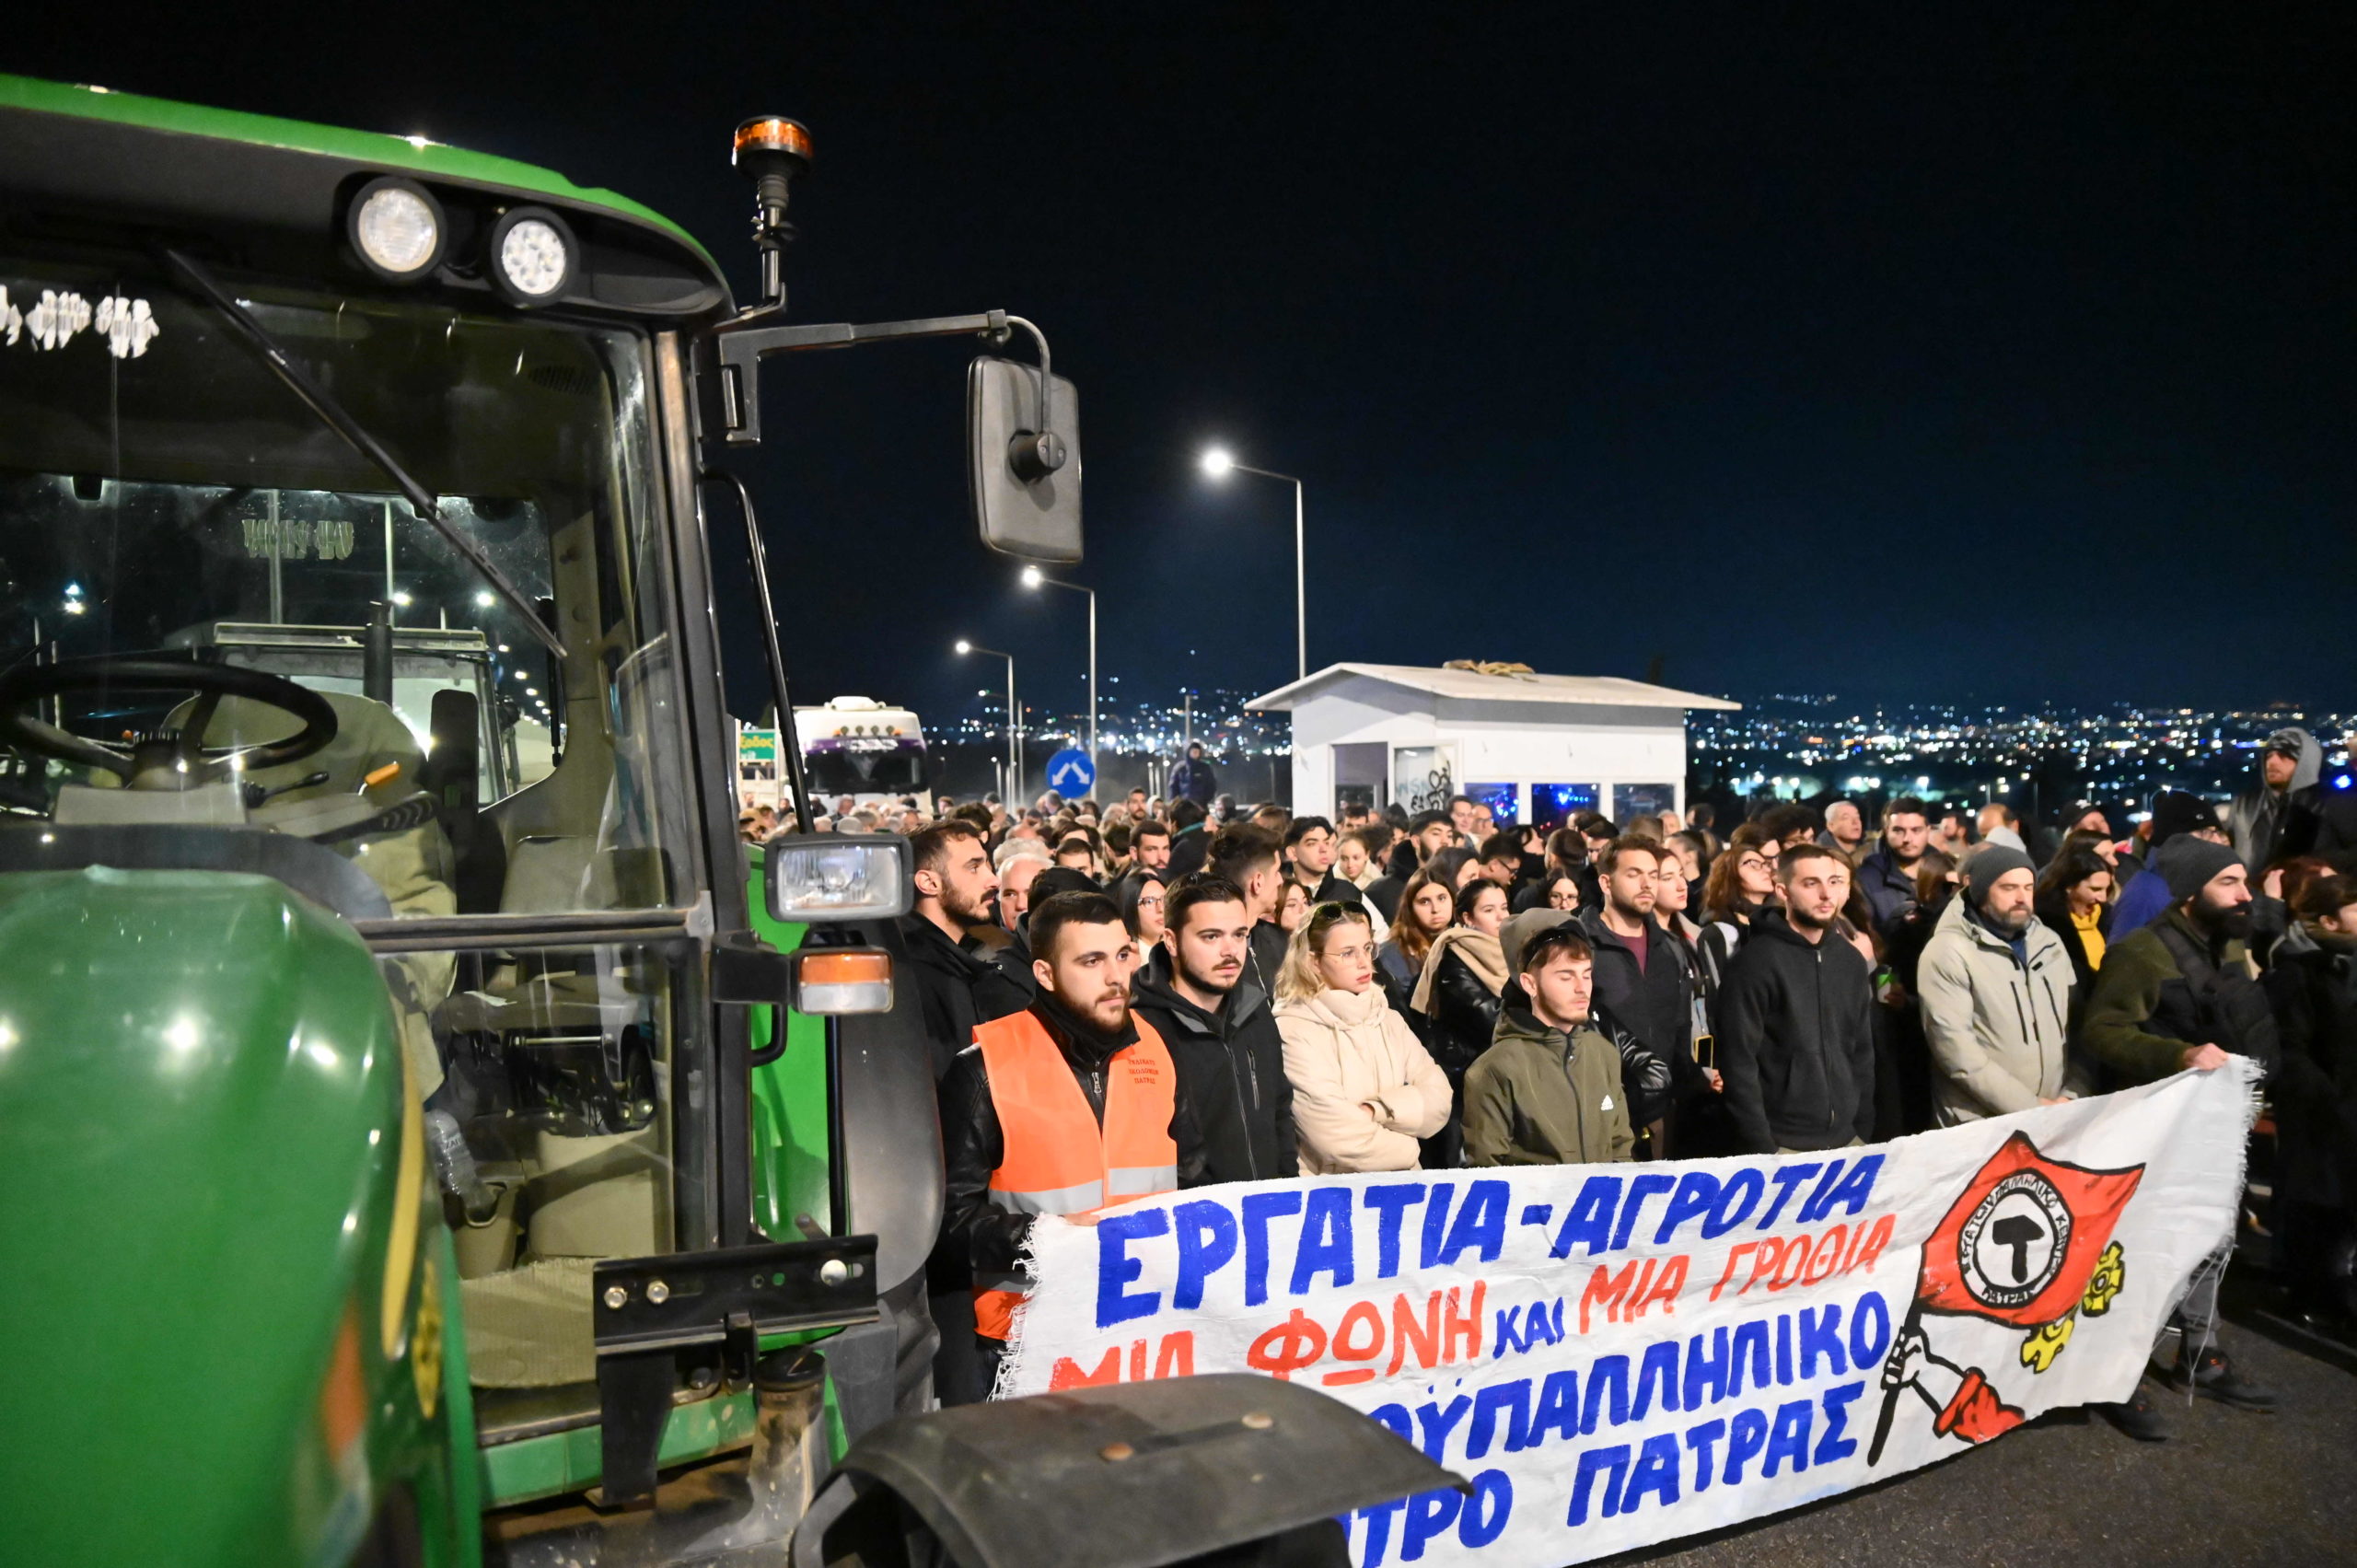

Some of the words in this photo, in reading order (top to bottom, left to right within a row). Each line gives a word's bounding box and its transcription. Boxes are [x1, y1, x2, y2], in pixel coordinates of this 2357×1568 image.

[738, 733, 773, 746] ξοδος
[1248, 1280, 1486, 1387] ΦΩΝΗ
[1493, 1296, 1565, 1359] ΚΑΙ
[1580, 1255, 1689, 1334] ΜΙΑ
[1710, 1214, 1895, 1302] ΓΡΟΘΙΑ
[1567, 1381, 1865, 1527] ΠΑΤΡΑΣ
